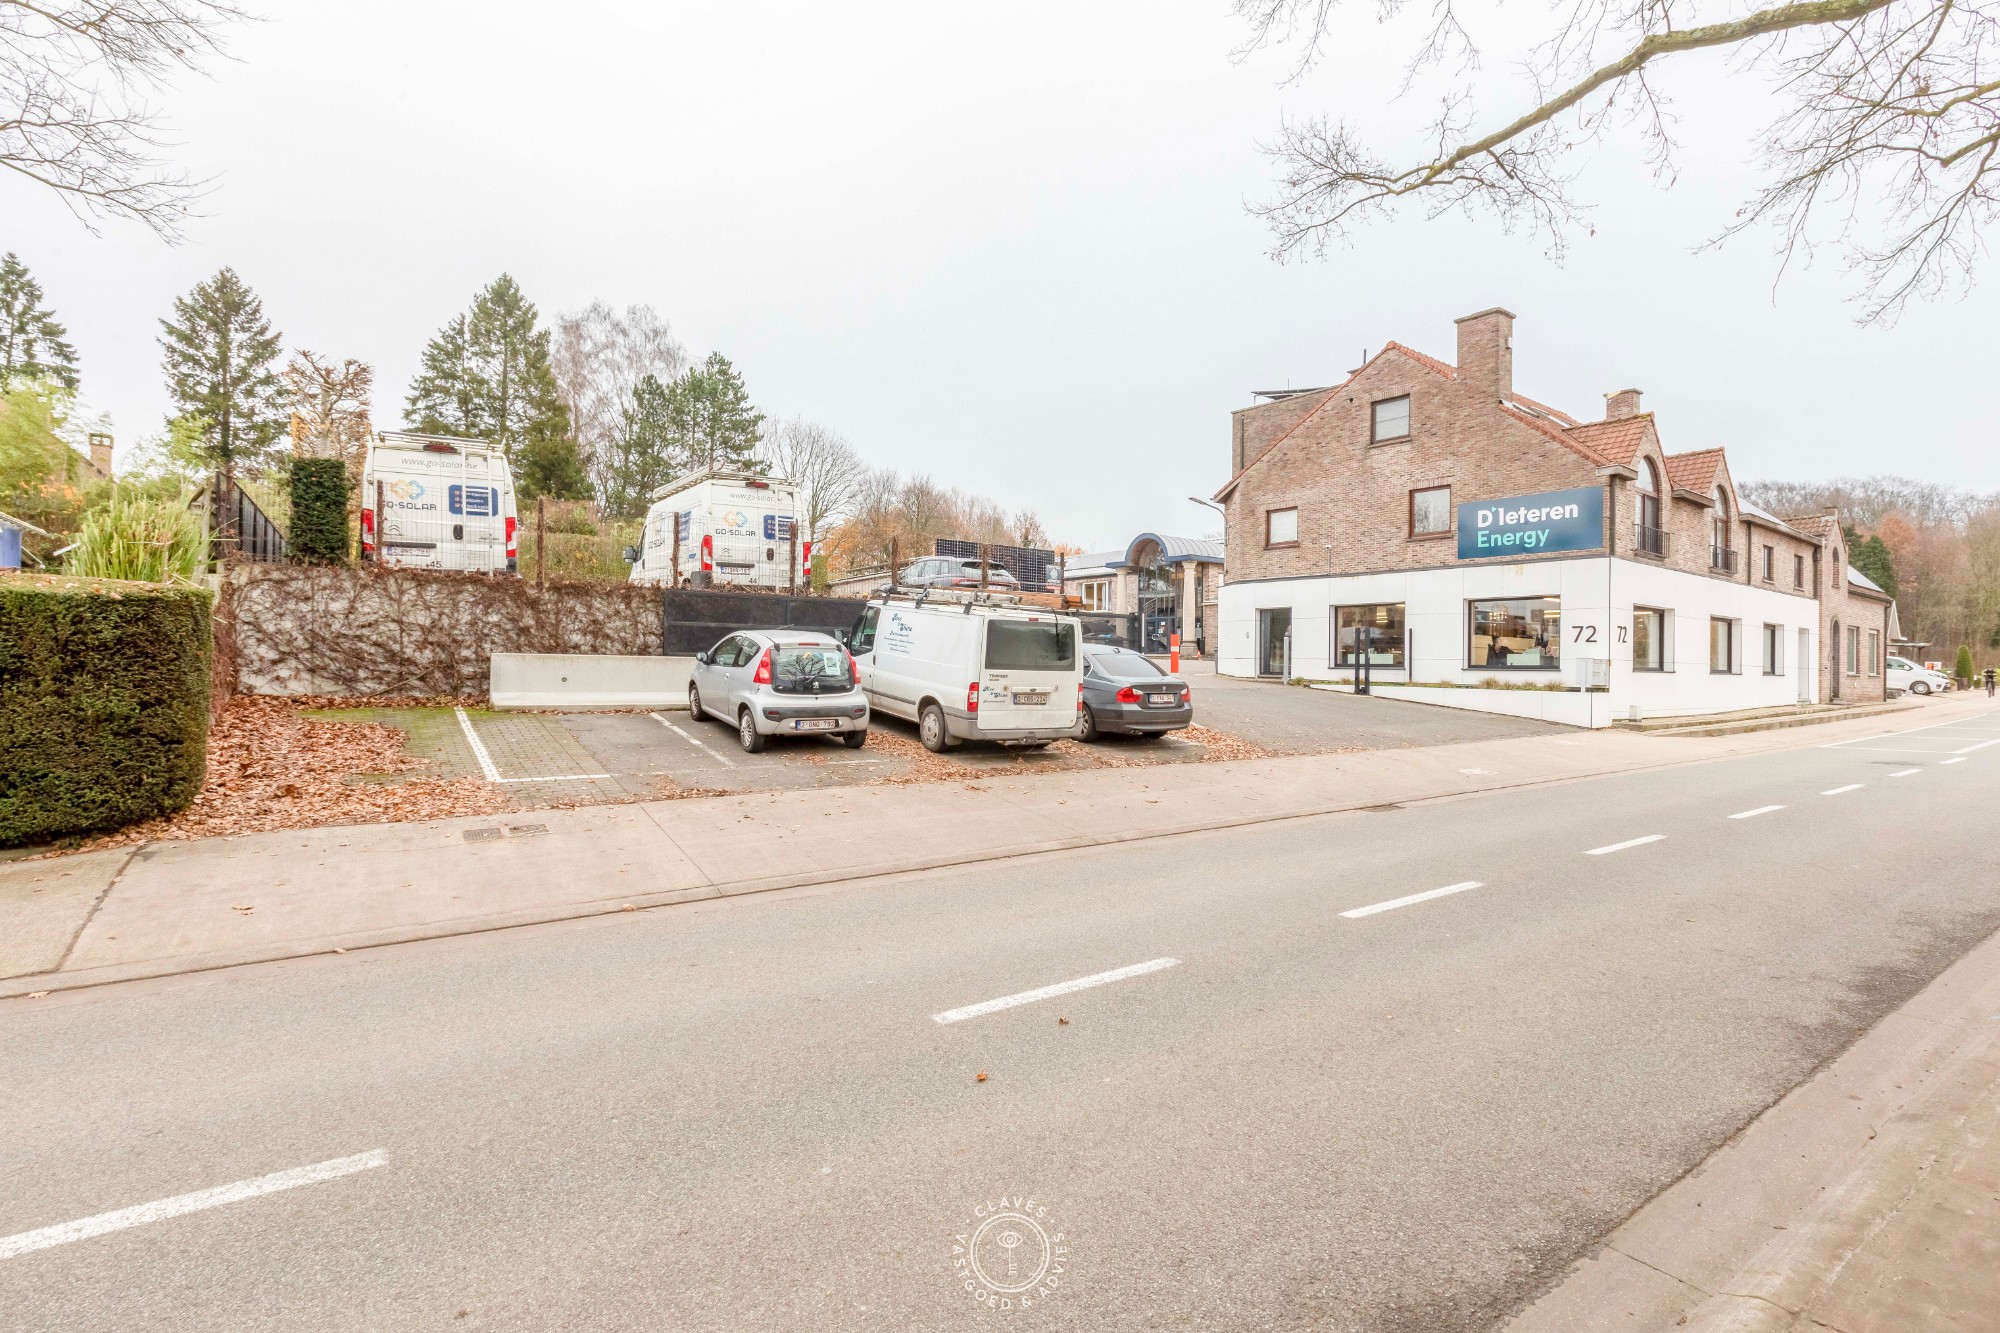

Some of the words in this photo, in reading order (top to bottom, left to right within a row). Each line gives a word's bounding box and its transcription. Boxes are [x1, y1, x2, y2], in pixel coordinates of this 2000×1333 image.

[401, 457, 478, 470] www.go-solarbe
[1477, 528, 1550, 548] Energy
[429, 560, 442, 568] 45
[1571, 625, 1598, 643] 72
[1616, 625, 1628, 644] 72
